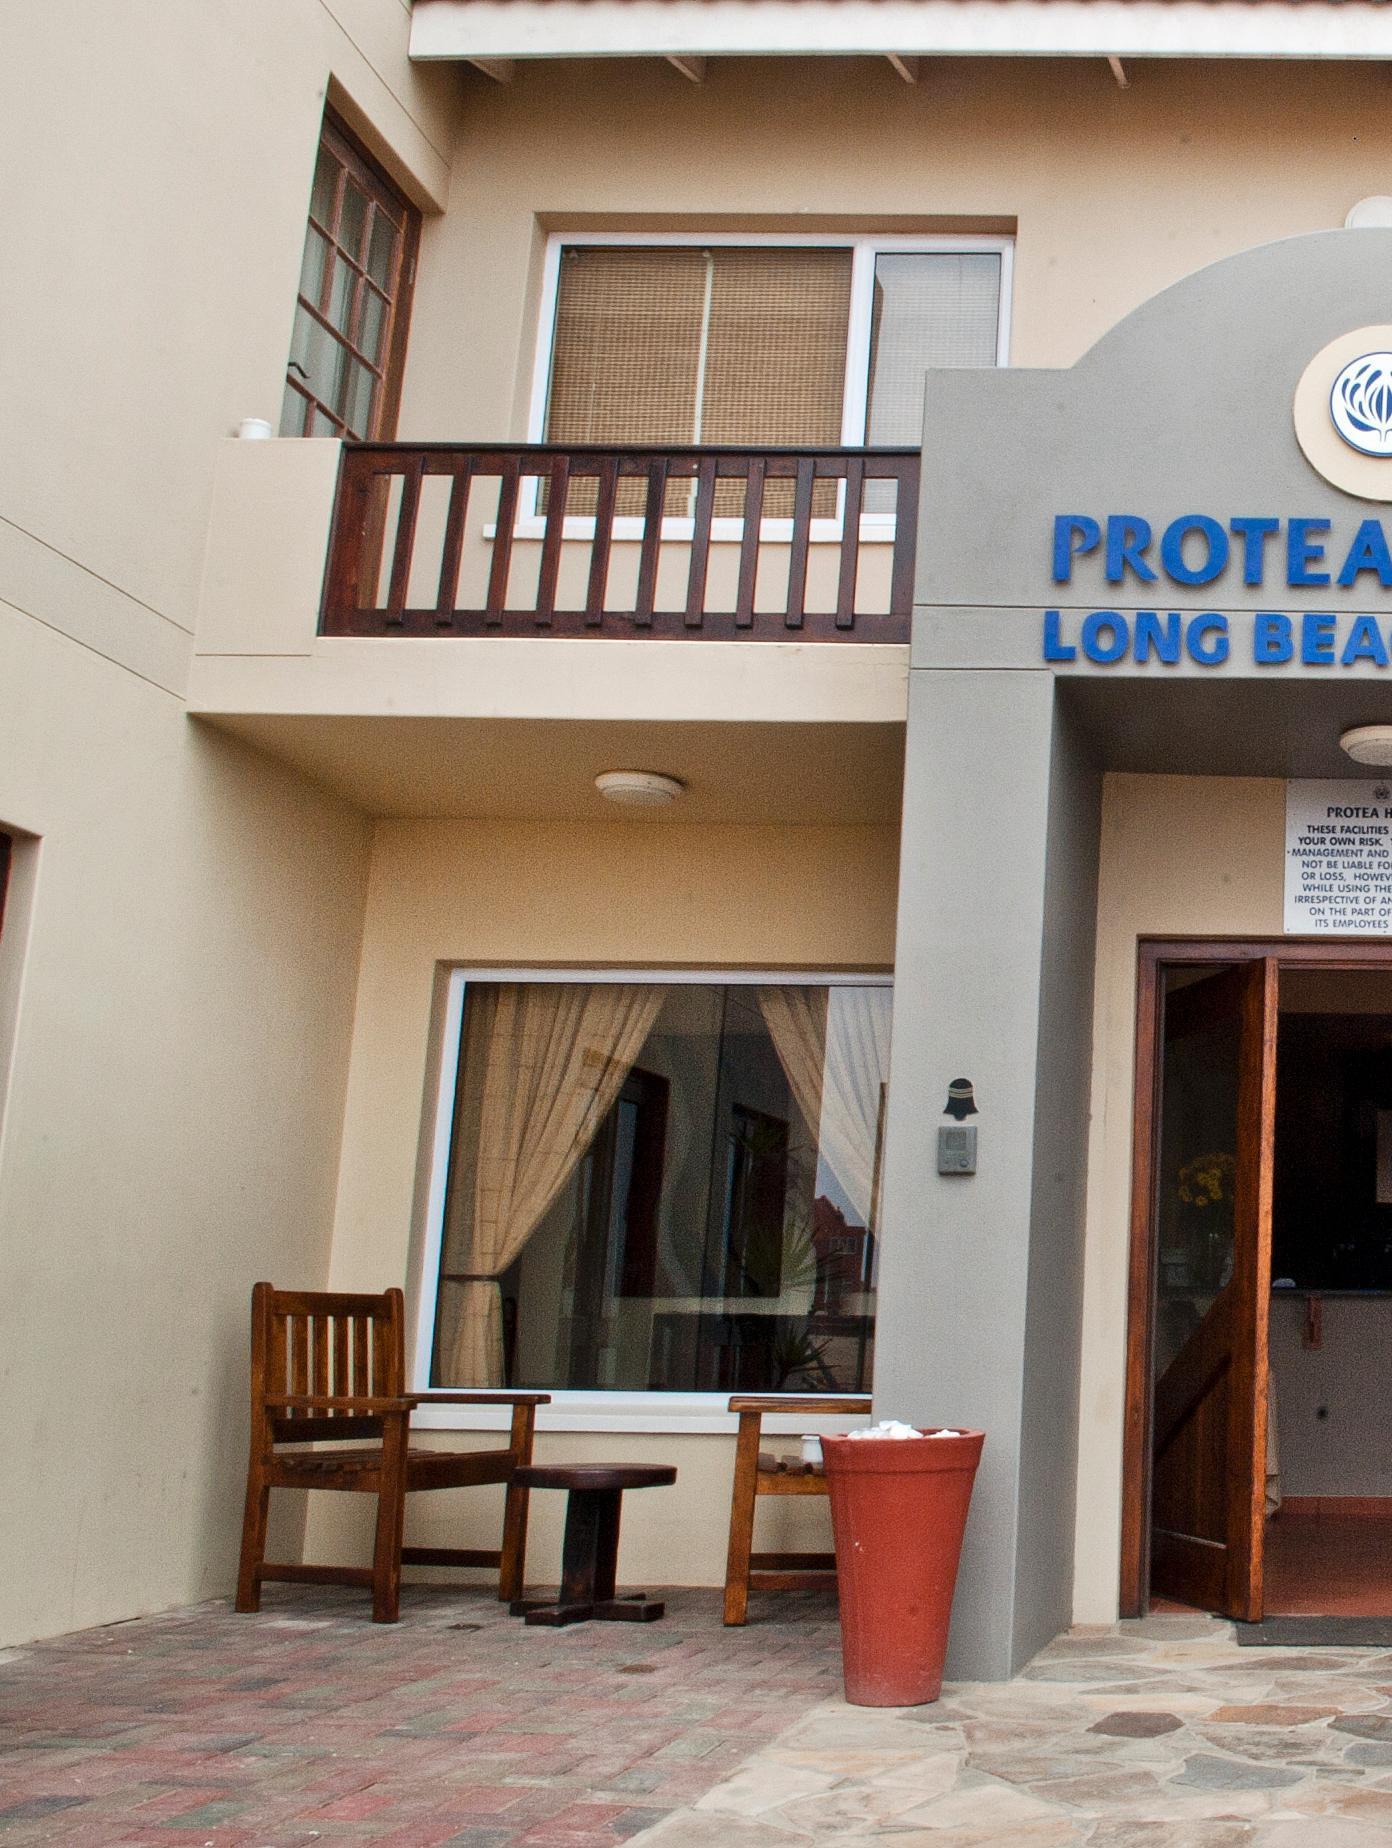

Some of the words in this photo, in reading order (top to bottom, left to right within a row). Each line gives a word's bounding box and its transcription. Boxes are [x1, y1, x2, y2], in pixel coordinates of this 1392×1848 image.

[1043, 610, 1230, 664] LONG
[1327, 806, 1379, 818] PROTEA
[1307, 825, 1337, 834] THESE
[1340, 825, 1389, 835] FACILITIES
[1298, 836, 1326, 846] YOUR
[1329, 837, 1355, 846] OWN
[1291, 848, 1363, 858] MANAGEMENT
[1366, 849, 1389, 858] AND
[1301, 860, 1323, 869] NOT
[1326, 860, 1339, 869] BE
[1342, 860, 1374, 870] LIABLE
[1301, 871, 1316, 881] OR
[1302, 883, 1334, 893] WHILE
[1337, 884, 1370, 893] USING
[1294, 895, 1360, 904] IRRESPECTIVE
[1363, 896, 1377, 905] OF
[1309, 907, 1325, 916] ON
[1329, 907, 1348, 916] THE
[1351, 907, 1375, 917] PART
[1378, 908, 1391, 917] OF
[1315, 918, 1329, 928] ITS
[1332, 919, 1389, 928] EMPLOYEES
